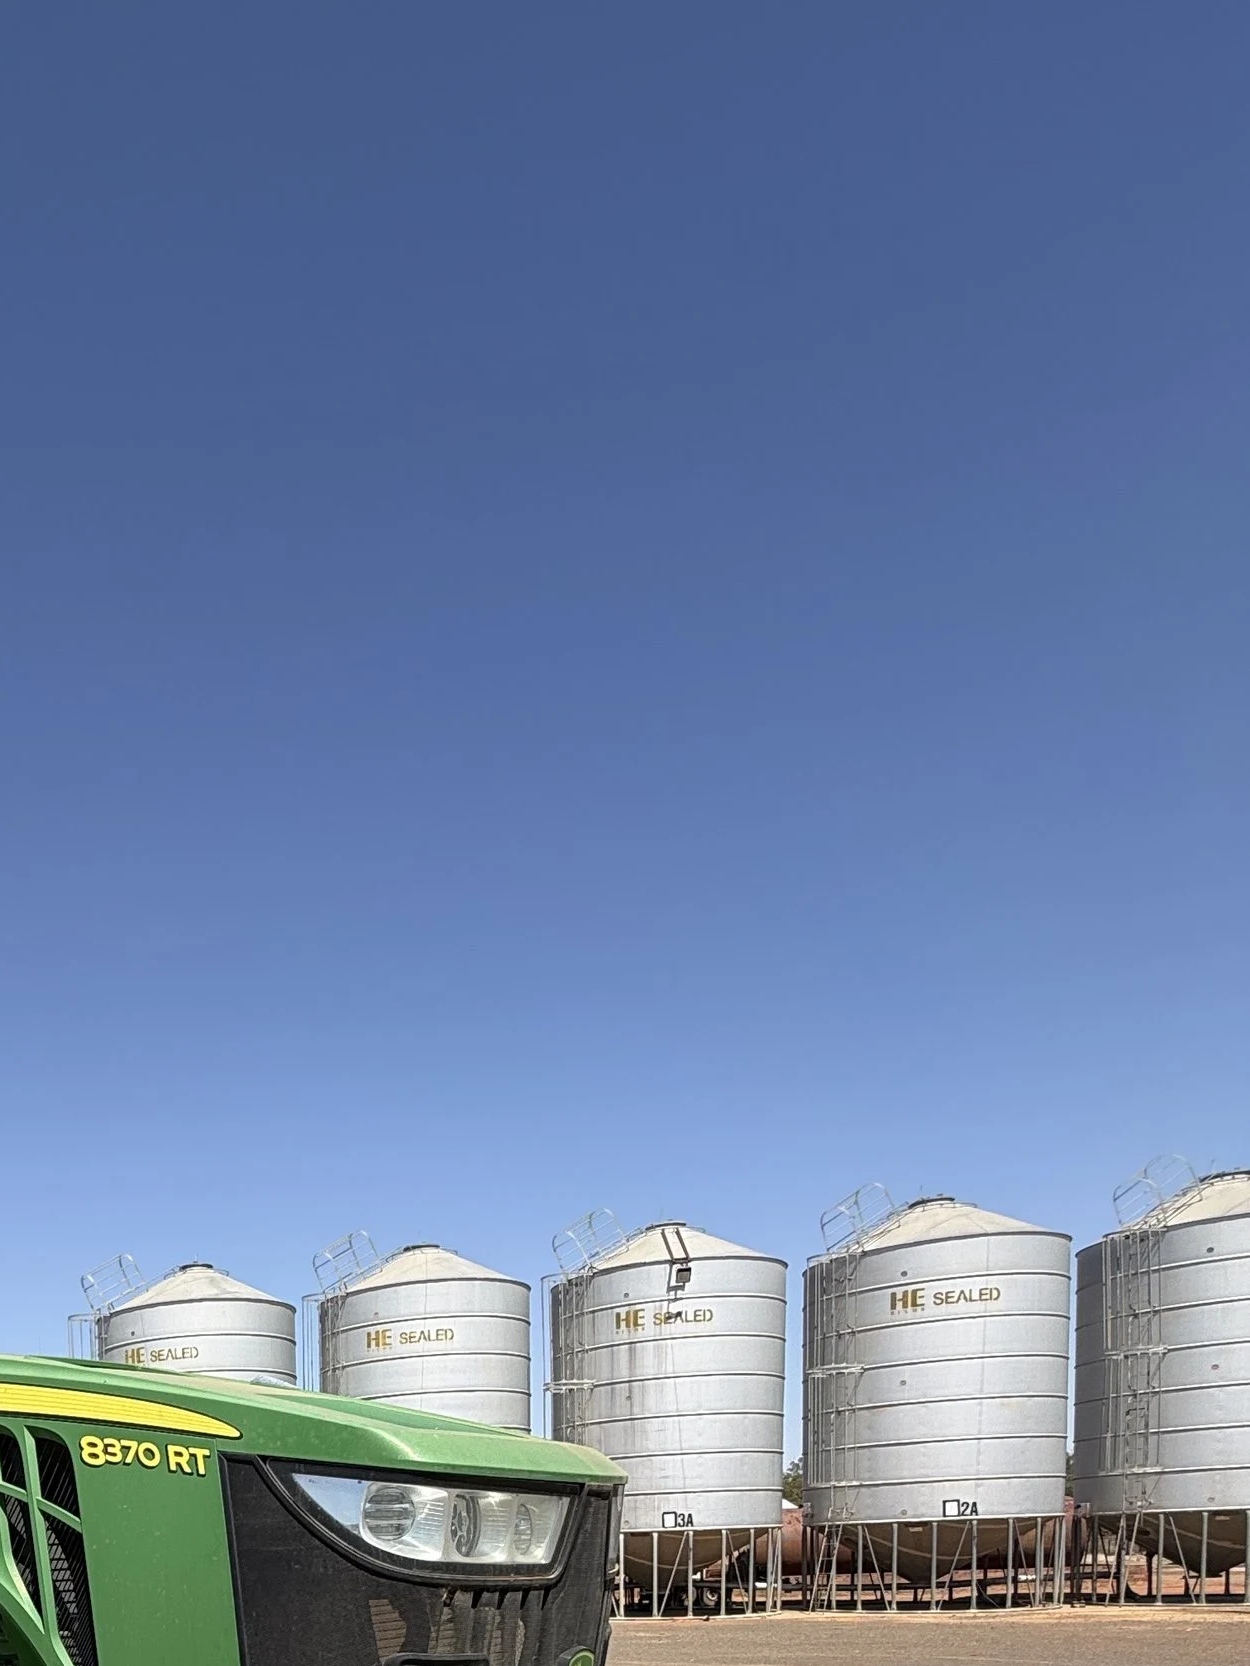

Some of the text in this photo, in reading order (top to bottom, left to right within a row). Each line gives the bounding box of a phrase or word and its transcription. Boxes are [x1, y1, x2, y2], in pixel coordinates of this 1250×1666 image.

[890, 1286, 1001, 1310] HE SEALED
[615, 1308, 714, 1329] HE SEALED
[366, 1328, 455, 1348] HE SEALED
[125, 1346, 199, 1364] HE SEALED
[79, 1435, 210, 1477] 8370 RT
[961, 1501, 979, 1516] 2A
[677, 1513, 694, 1528] 3A
